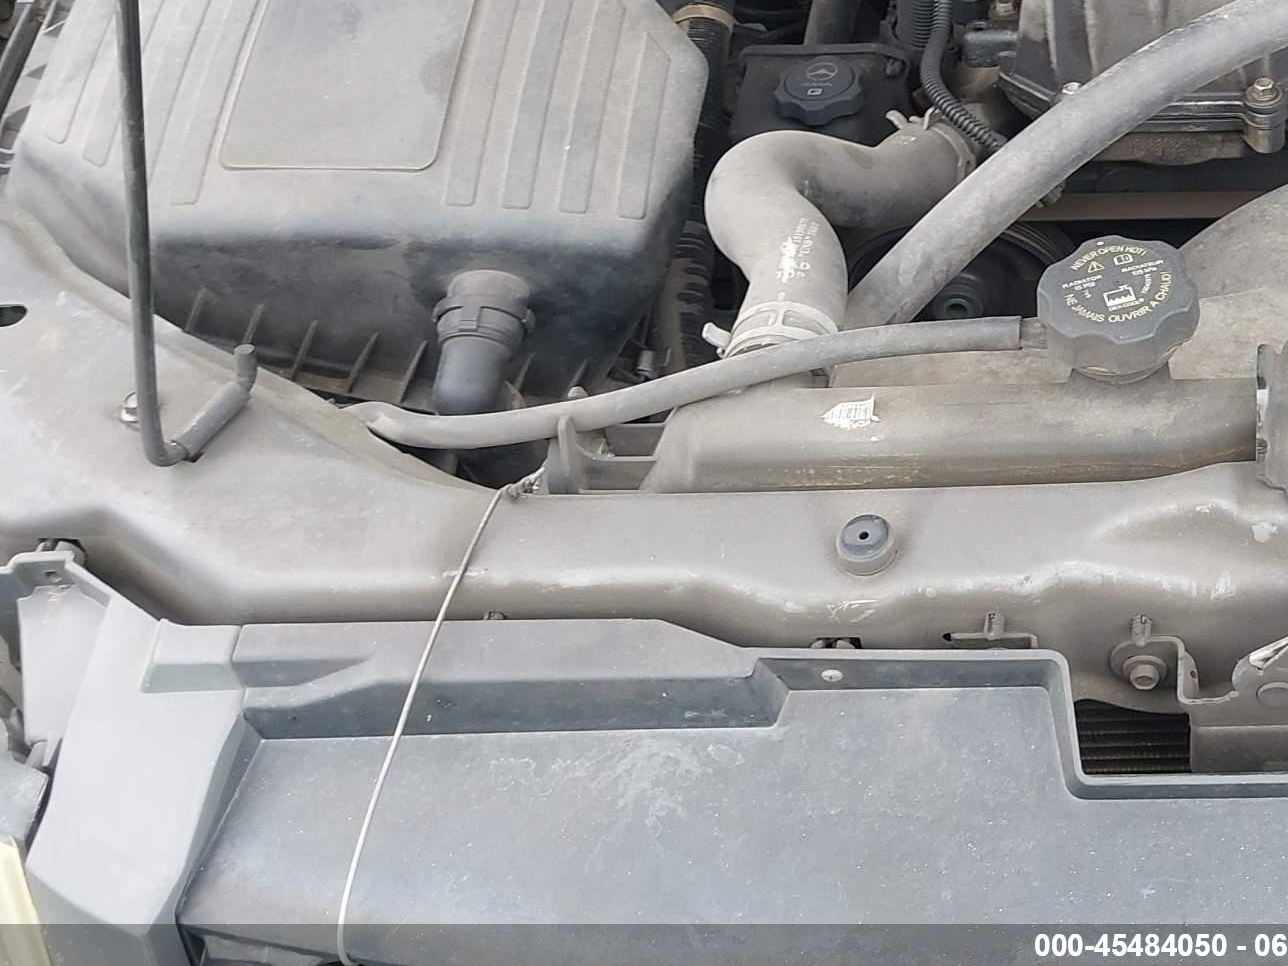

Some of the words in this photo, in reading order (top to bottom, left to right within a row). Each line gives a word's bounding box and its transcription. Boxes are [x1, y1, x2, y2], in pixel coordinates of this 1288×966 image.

[1070, 251, 1098, 271] NEVER
[1098, 245, 1125, 255] OPEN
[1064, 293, 1078, 307] NE
[1072, 303, 1105, 323] JAMAIS
[1108, 306, 1152, 323] OUVRIR
